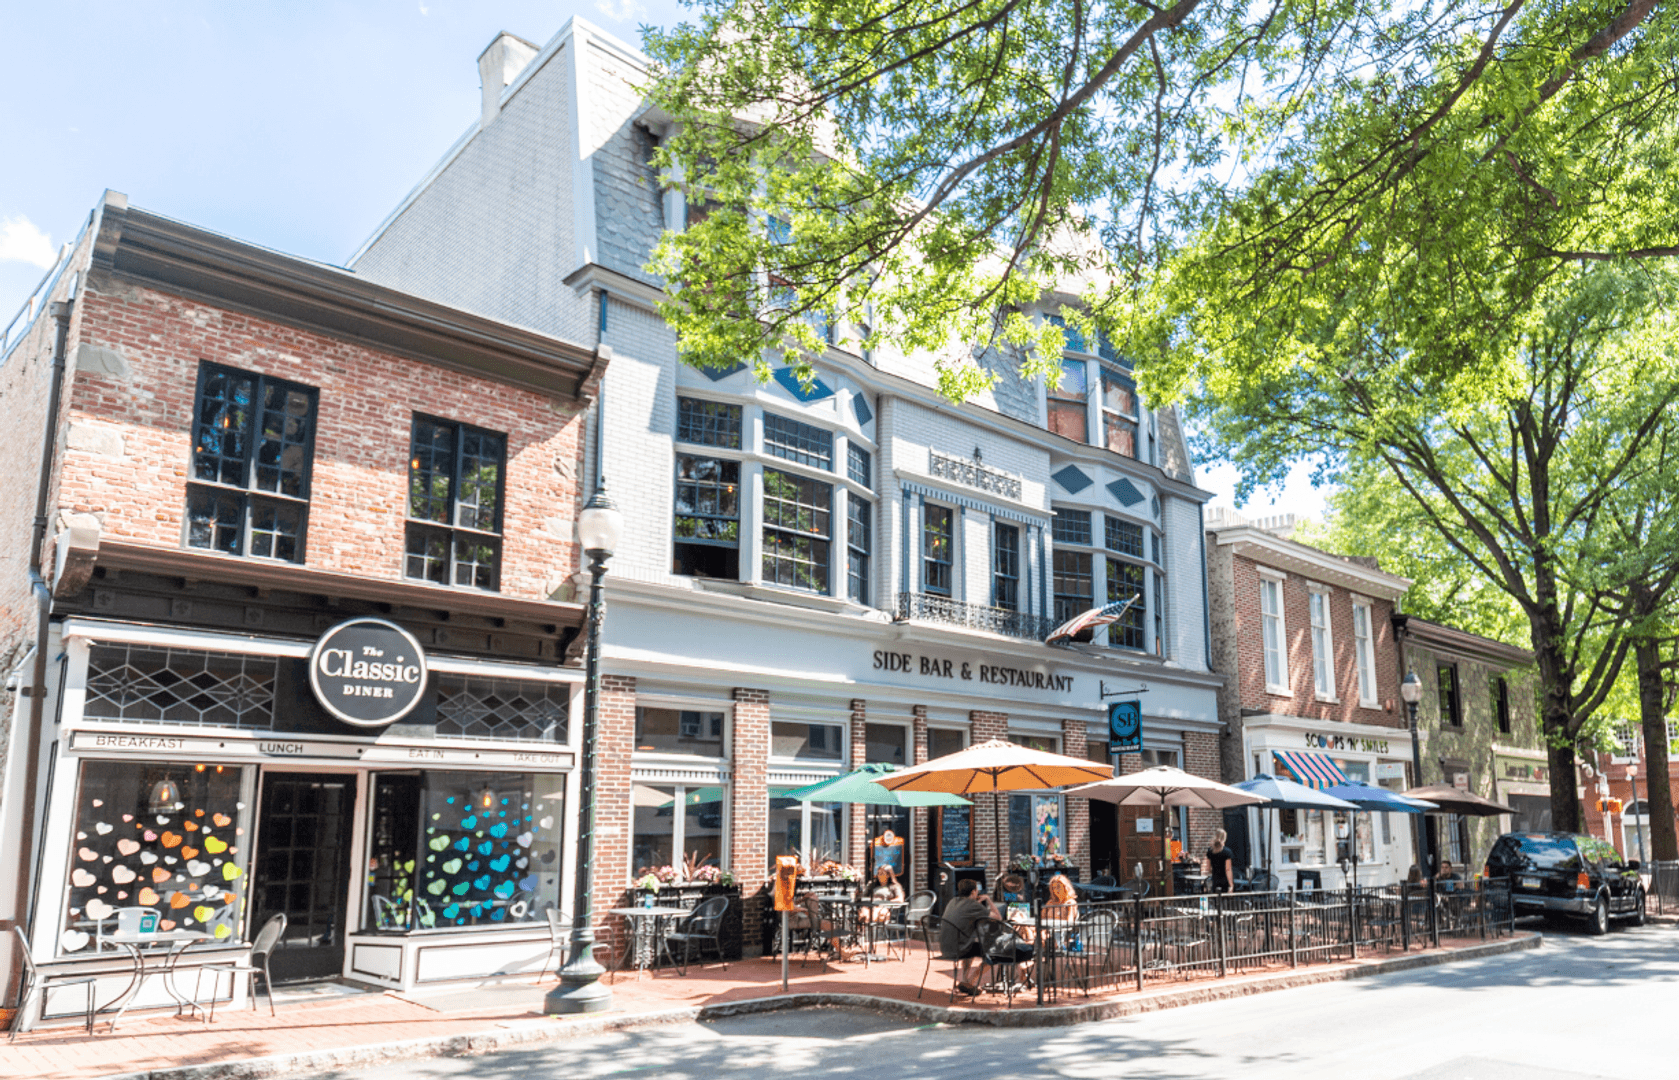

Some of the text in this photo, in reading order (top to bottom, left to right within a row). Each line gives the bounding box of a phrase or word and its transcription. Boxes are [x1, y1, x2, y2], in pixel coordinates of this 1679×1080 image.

[362, 646, 384, 657] The
[319, 648, 419, 683] Classic
[873, 650, 1074, 693] SIDE BAR & RESTAURANT
[342, 684, 394, 698] DINER
[1117, 712, 1138, 728] SB
[96, 736, 560, 763] BREAKFAST LUNCH EAT IN TAKE OUT
